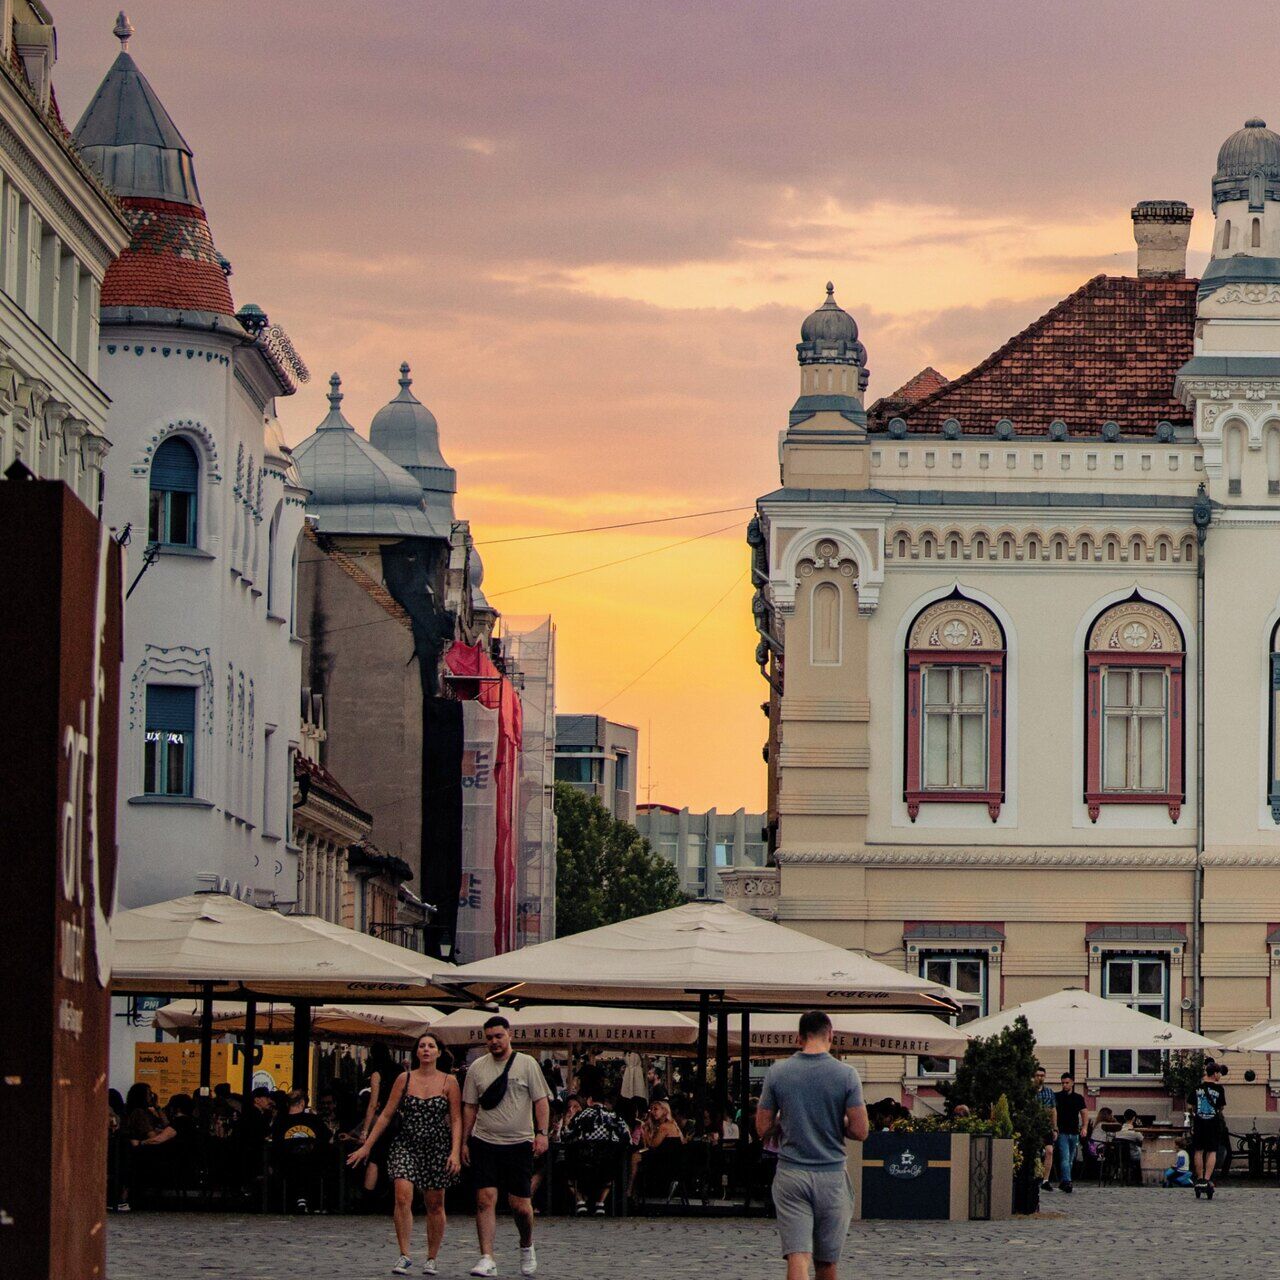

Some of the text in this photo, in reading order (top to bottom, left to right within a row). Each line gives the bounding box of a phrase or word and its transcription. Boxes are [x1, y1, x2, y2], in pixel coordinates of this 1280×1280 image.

[534, 1028, 571, 1038] MERGE
[578, 1028, 599, 1039] MAI
[606, 1029, 656, 1039] DEPARTE
[853, 1037, 873, 1047] MAI
[880, 1040, 930, 1051] DEPARTE
